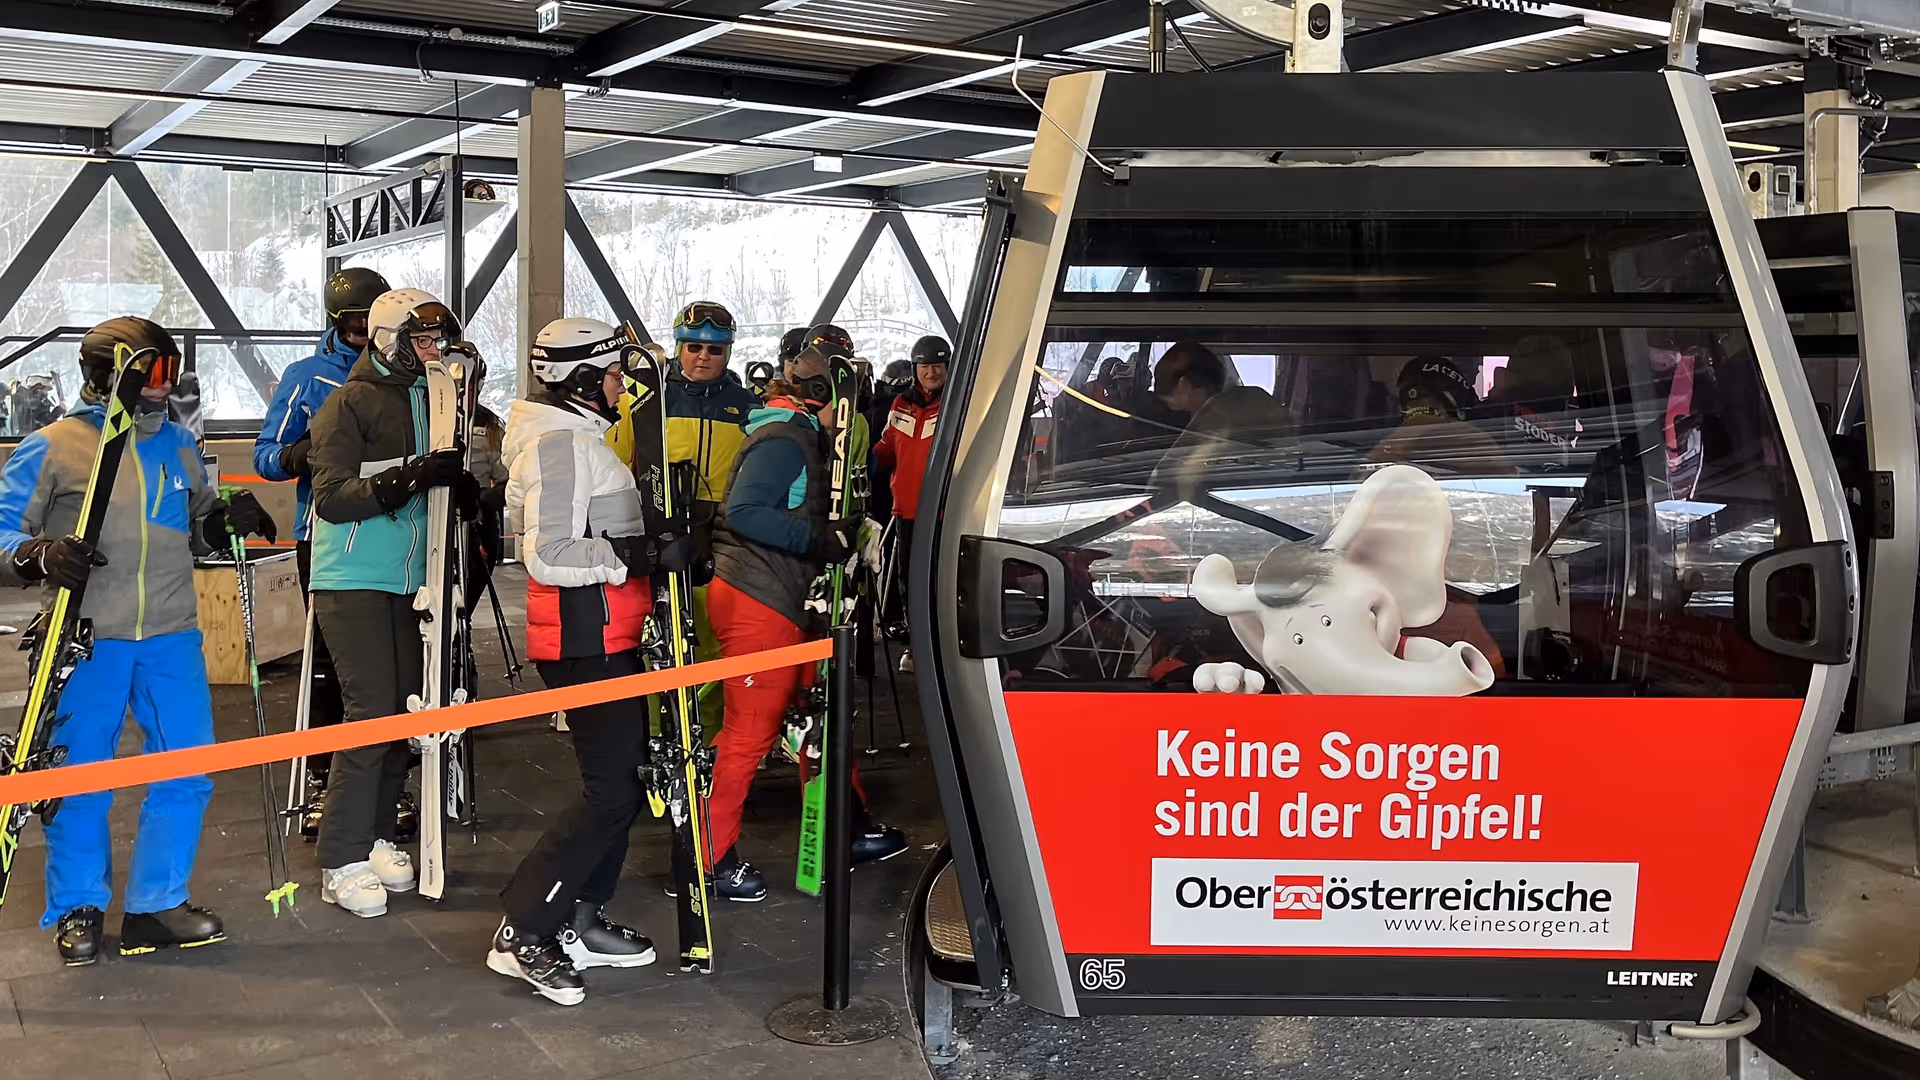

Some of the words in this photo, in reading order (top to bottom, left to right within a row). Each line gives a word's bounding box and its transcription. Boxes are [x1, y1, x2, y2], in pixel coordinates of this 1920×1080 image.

[828, 396, 850, 521] HEAD
[1156, 728, 1301, 779] Keine
[1318, 730, 1500, 792] Sorgen
[1153, 788, 1260, 838] sind
[1279, 792, 1363, 839] der
[1379, 791, 1543, 851] Gipfel!
[1175, 876, 1272, 909] Ober
[1325, 876, 1613, 912] österreichische
[1384, 915, 1611, 938] www.keinesorgen.at
[1079, 958, 1127, 990] 65
[1606, 970, 1695, 987] LEITNER
